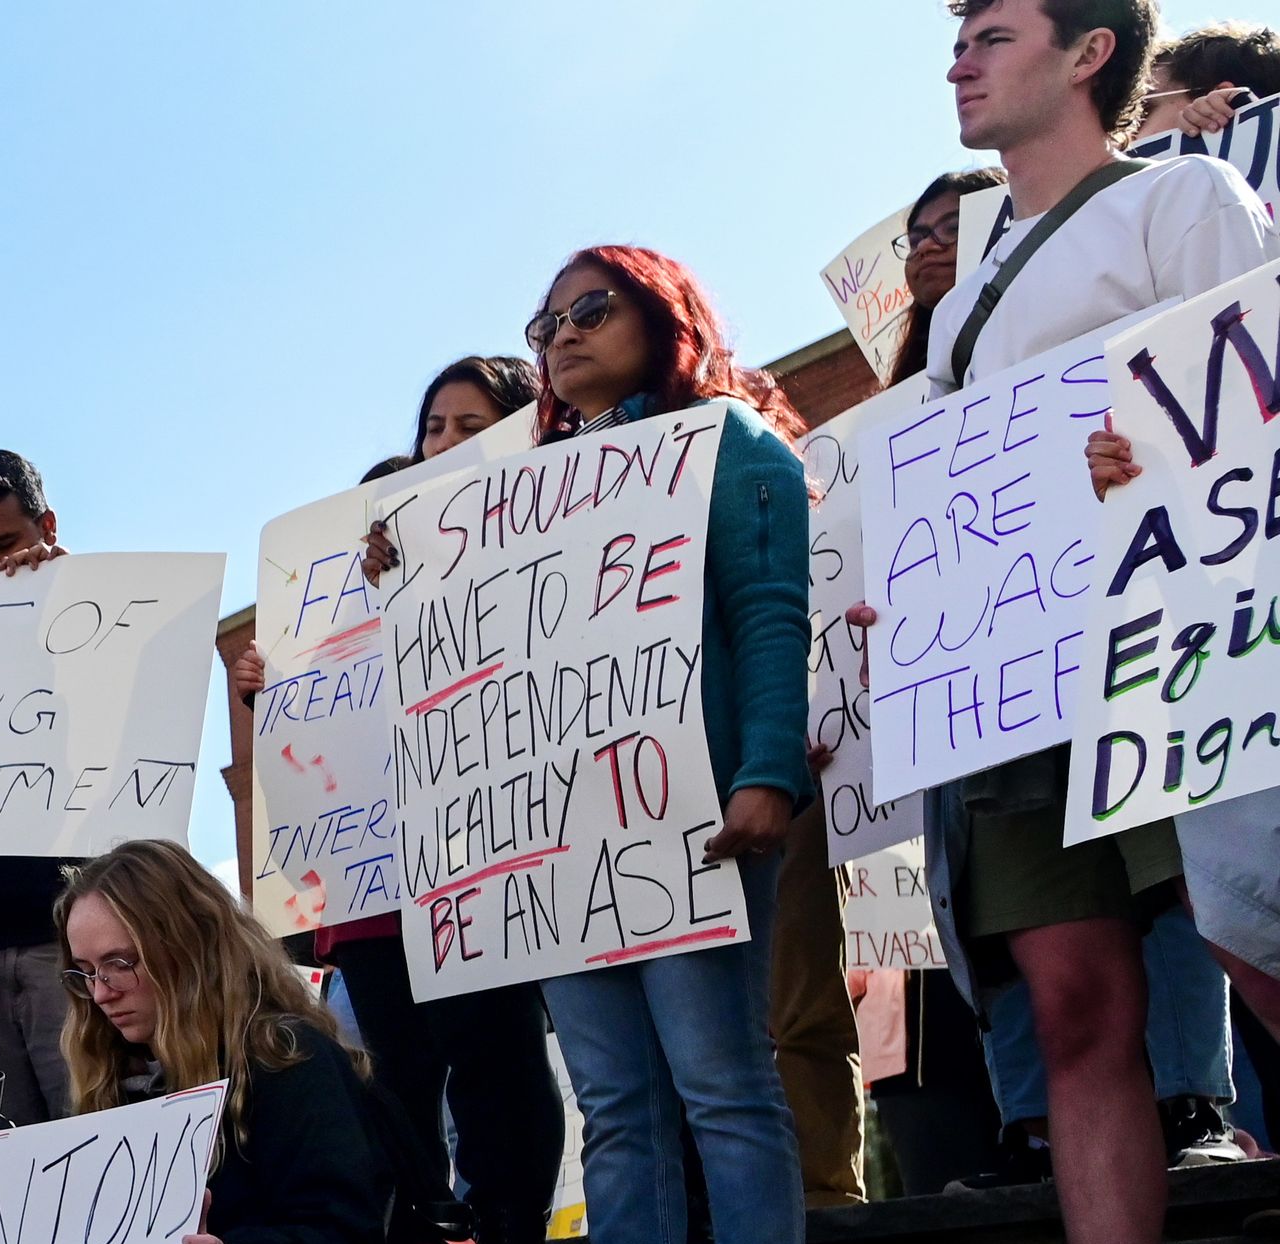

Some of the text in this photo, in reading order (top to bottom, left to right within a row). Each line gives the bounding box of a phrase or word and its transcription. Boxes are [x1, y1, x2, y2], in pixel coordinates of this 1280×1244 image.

[825, 252, 881, 304] We
[889, 356, 1112, 508] FEES
[385, 494, 424, 611] I
[439, 422, 716, 580] SHOULDN'T
[888, 472, 1036, 606] ARE
[45, 599, 159, 655] OF
[295, 551, 381, 639] FA
[394, 533, 693, 705] HAVE TO BE
[393, 637, 702, 810] INDEPENDENTLY
[874, 630, 1084, 767] THEF
[256, 799, 397, 881] INTER
[401, 731, 669, 899] WEALTHY TO
[895, 866, 927, 897] EX
[344, 852, 401, 915] TA
[429, 820, 732, 974] BE AN ASE
